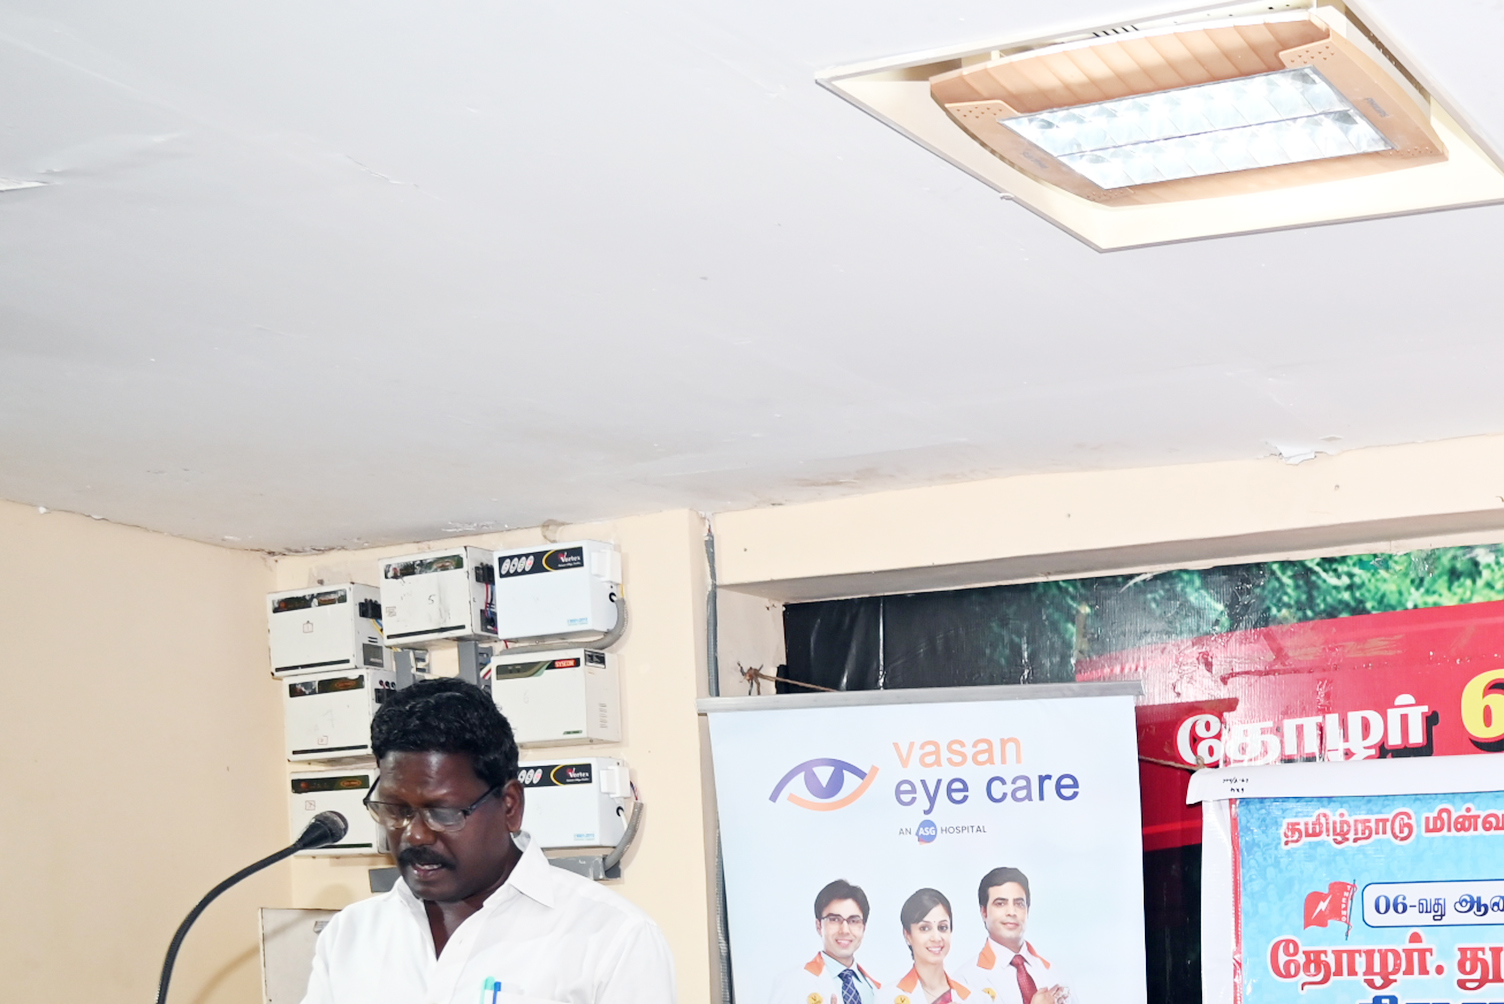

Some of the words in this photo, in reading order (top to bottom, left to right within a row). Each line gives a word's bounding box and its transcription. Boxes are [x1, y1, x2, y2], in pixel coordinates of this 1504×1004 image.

[1176, 694, 1429, 766] தோழர்
[892, 736, 1023, 768] vasan
[894, 777, 969, 815] eye
[986, 773, 1080, 803] care
[898, 827, 912, 836] AN
[918, 826, 936, 836] ASG
[940, 825, 987, 835] HOSPITAL
[1283, 811, 1414, 845] தமிழ்நாடு
[1374, 893, 1447, 921] 06-வது
[1268, 932, 1445, 990] தோழர்.
